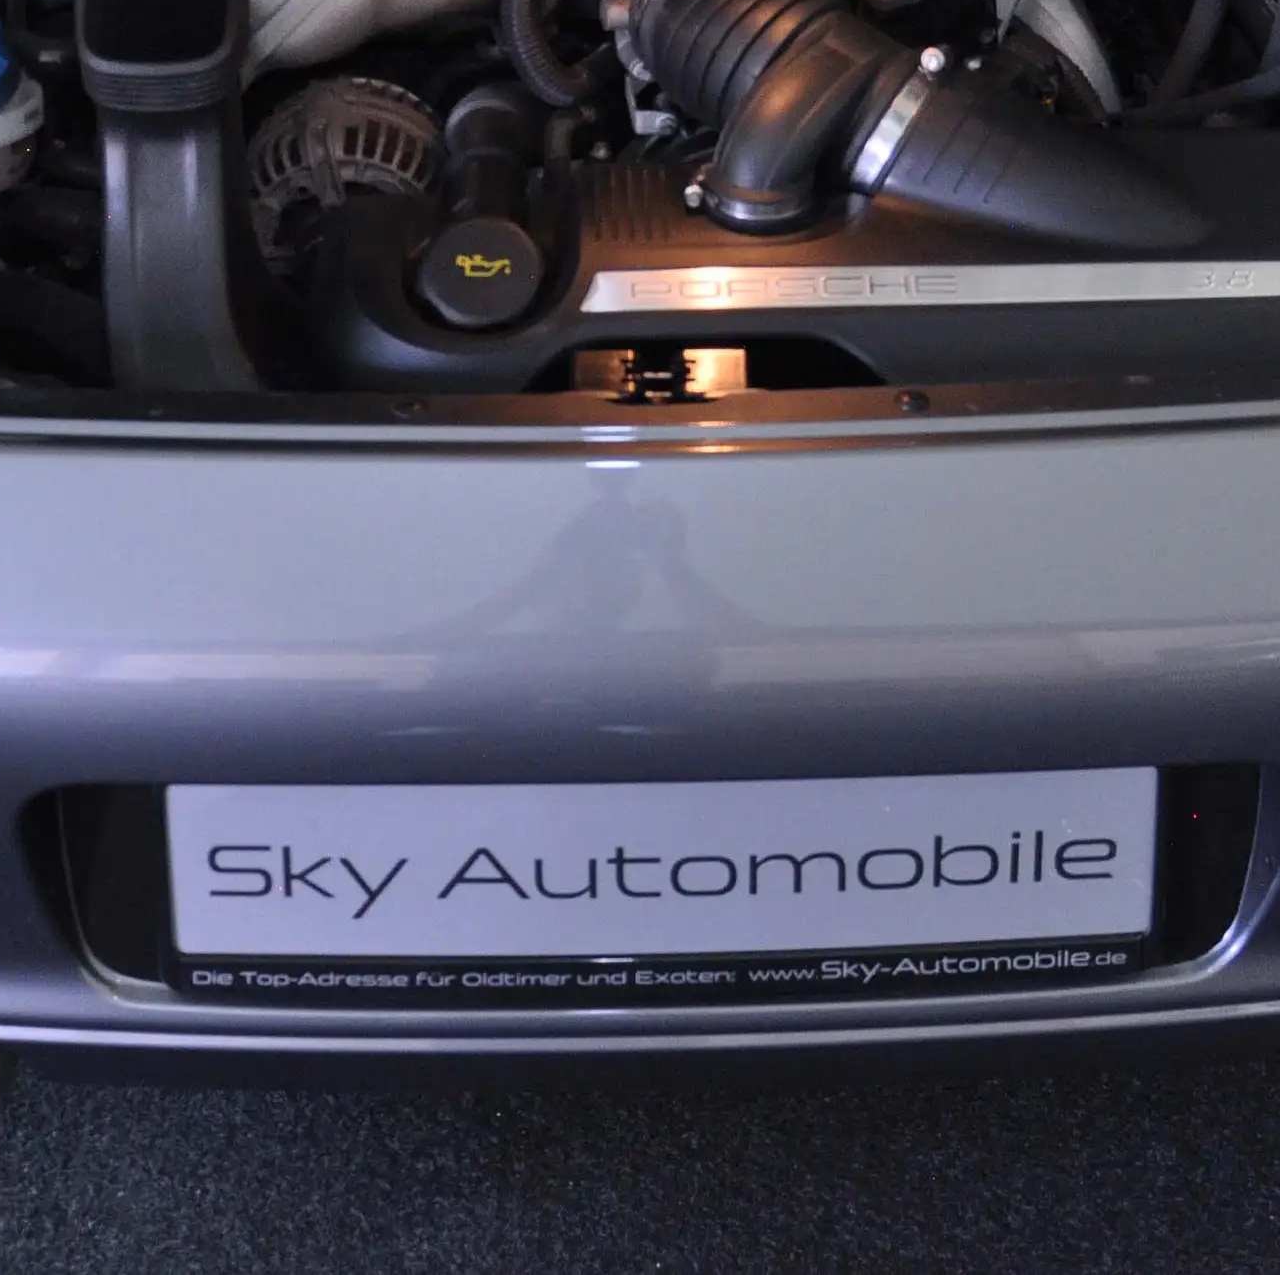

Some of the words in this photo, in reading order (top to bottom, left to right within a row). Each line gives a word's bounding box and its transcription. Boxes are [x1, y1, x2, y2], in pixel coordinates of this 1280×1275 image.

[630, 275, 959, 300] PORSCHE
[206, 844, 410, 920] Sky
[436, 829, 1118, 901] Automobile
[191, 969, 234, 986] Die
[239, 970, 409, 988] Top-Adresse
[415, 969, 454, 987] für
[461, 969, 571, 987] Oldtimer
[577, 970, 628, 986] und
[748, 948, 1128, 985] www.Sky-Automobile.de
